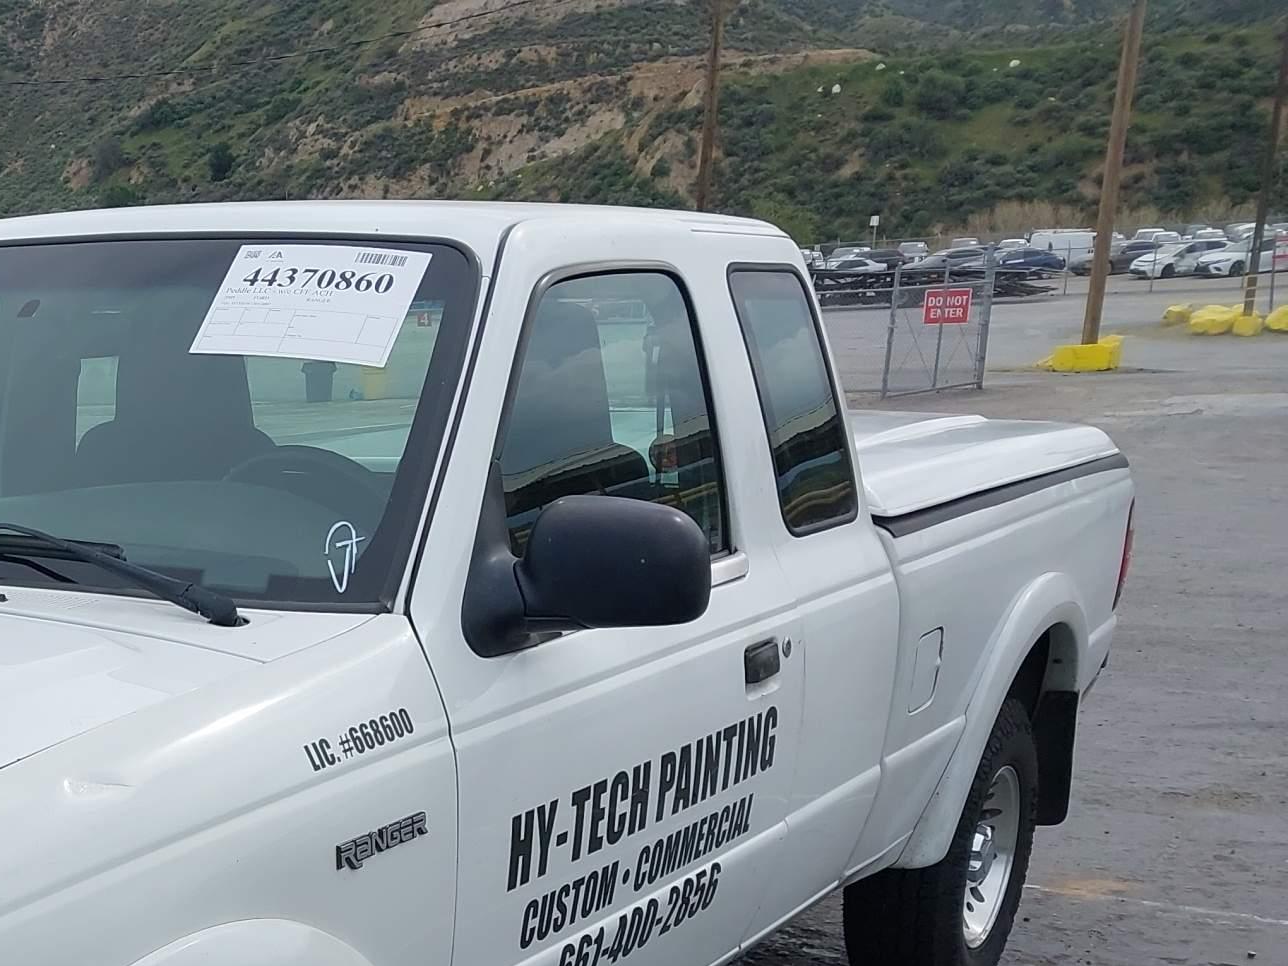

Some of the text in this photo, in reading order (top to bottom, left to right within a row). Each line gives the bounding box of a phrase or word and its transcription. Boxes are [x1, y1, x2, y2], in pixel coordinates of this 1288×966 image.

[243, 267, 394, 293] 44370860
[928, 295, 969, 307] DO NOT
[930, 308, 963, 318] ENTER
[304, 708, 414, 771] LIC. #668600
[507, 706, 777, 892] HY-TECH PAINTING
[336, 811, 428, 870] RANGER
[520, 793, 754, 949] CUSTOM COMMERCIAL
